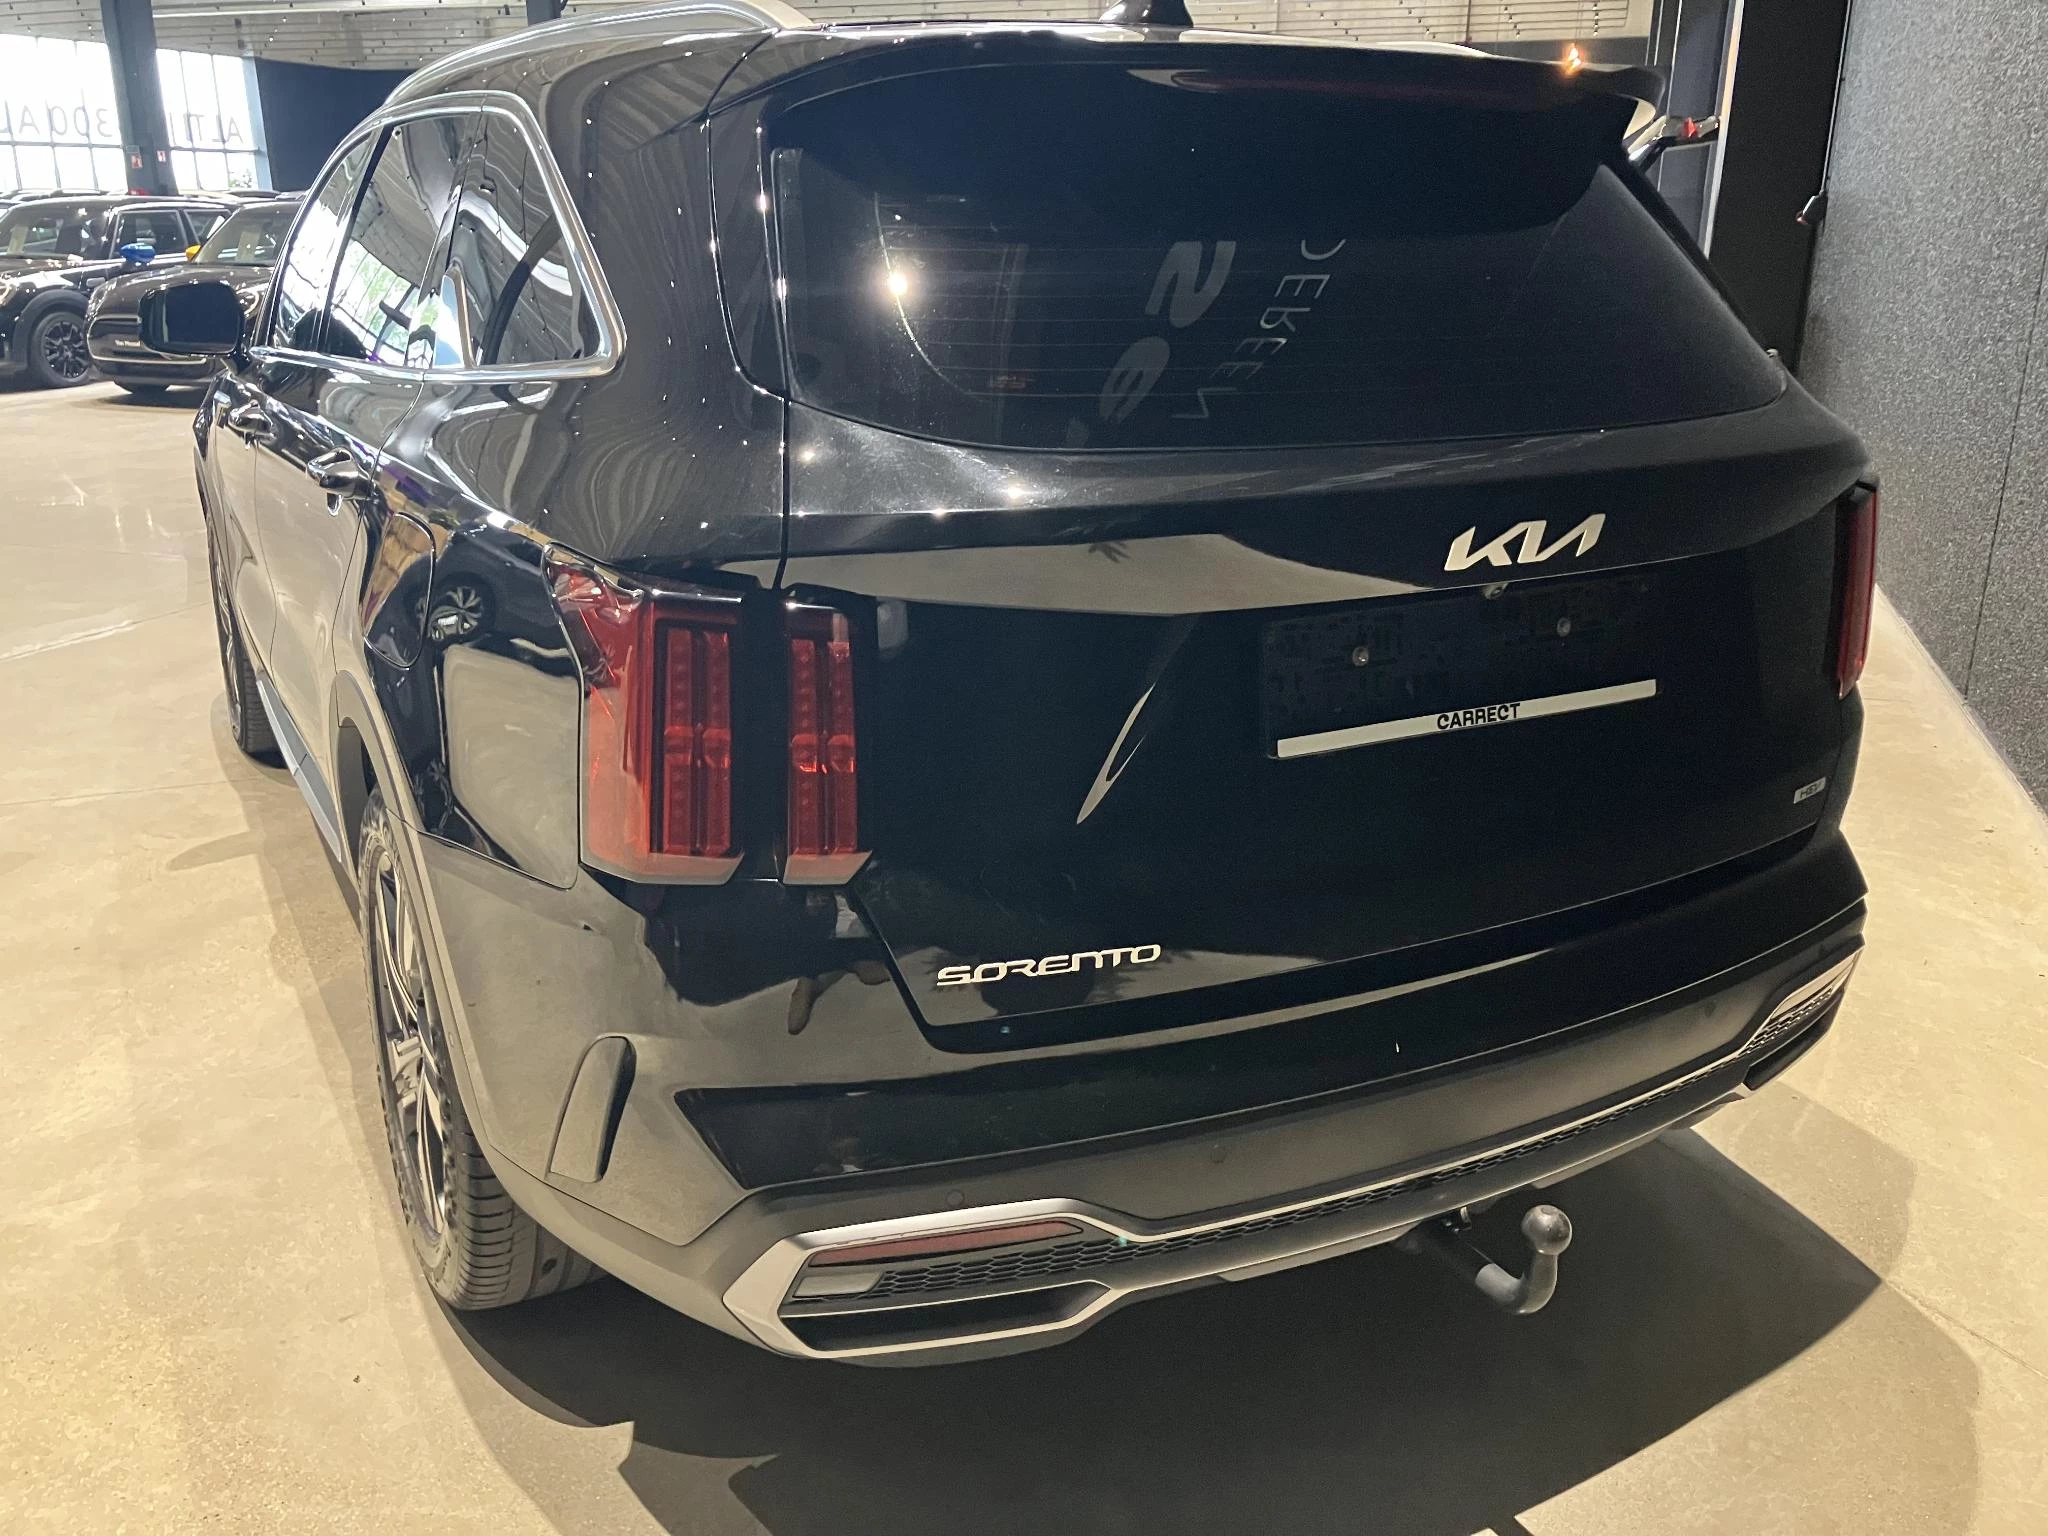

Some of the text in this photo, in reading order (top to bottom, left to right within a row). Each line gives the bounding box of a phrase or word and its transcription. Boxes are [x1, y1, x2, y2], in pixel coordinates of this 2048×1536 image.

[1444, 513, 1606, 571] KIA
[1437, 702, 1521, 730] CARRECT
[936, 943, 1161, 987] SORENTO
